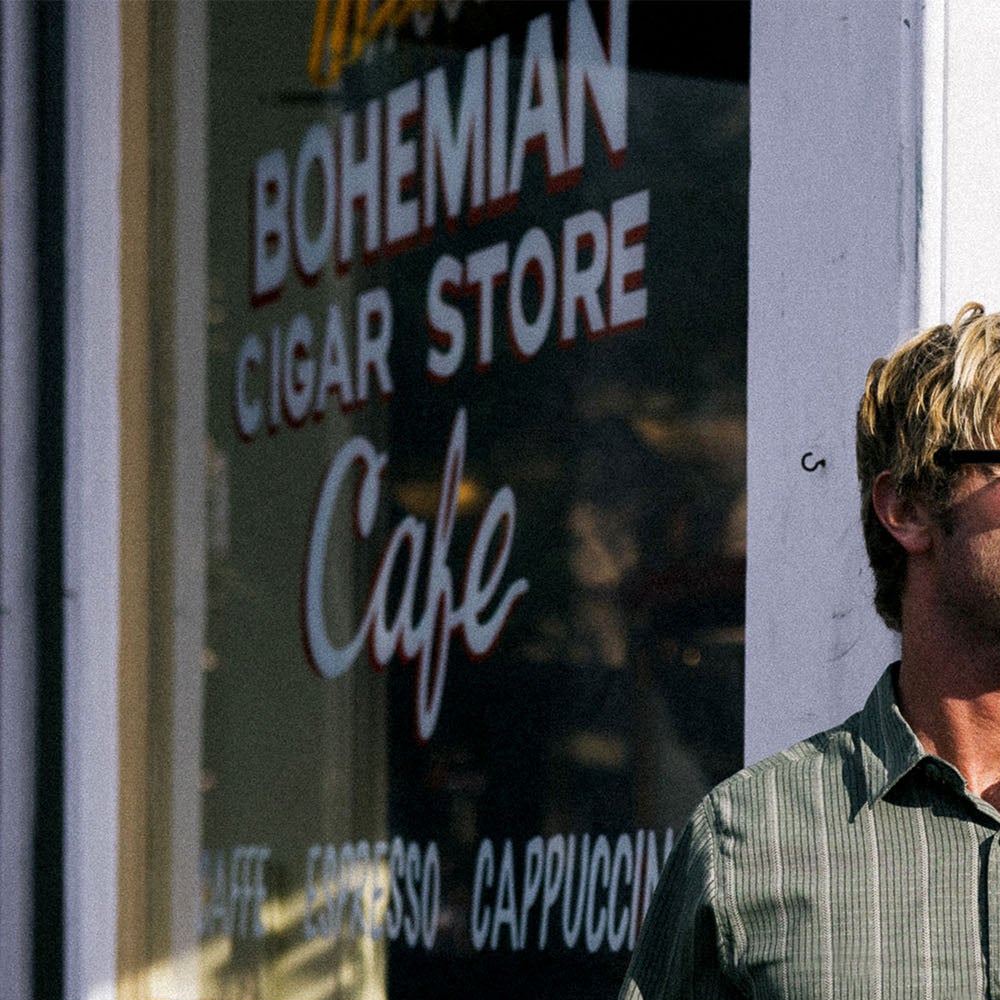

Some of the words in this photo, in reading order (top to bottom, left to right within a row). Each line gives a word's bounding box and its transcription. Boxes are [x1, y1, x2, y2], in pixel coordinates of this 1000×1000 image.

[253, 0, 630, 308] BOHEMIAN
[235, 287, 393, 442] CIGAR
[426, 189, 650, 383] STORE
[301, 407, 529, 746] Cafe
